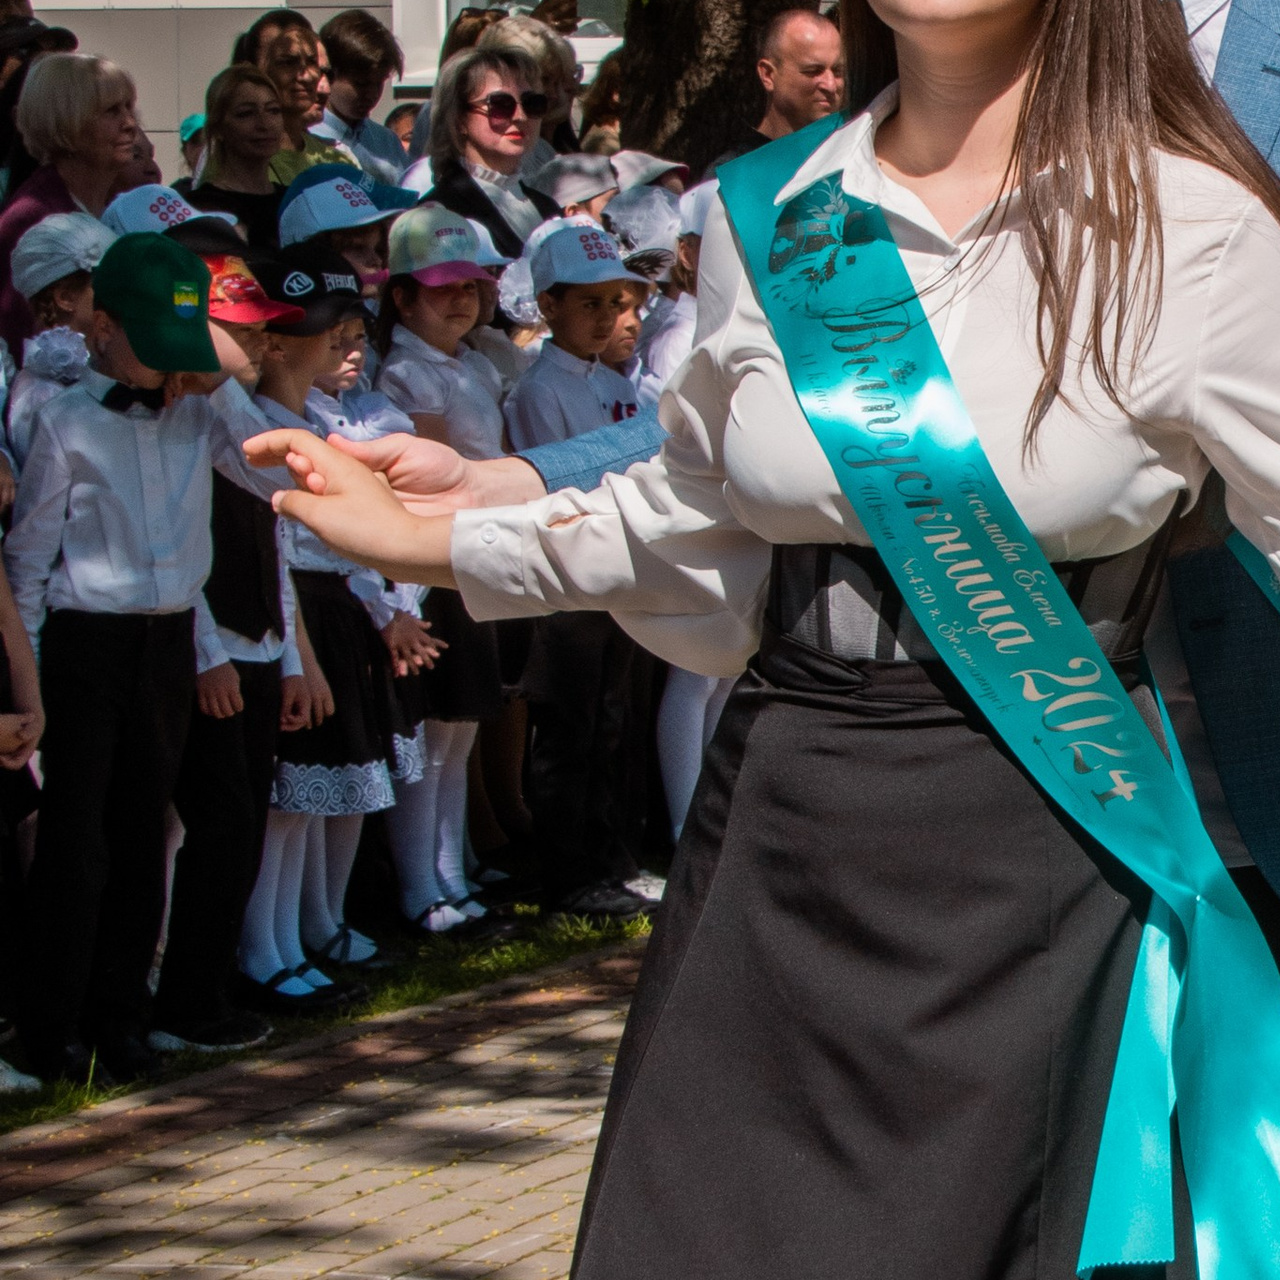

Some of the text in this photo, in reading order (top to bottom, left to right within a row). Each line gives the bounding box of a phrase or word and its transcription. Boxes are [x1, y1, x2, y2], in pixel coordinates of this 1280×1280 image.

[822, 297, 1150, 812] Выпускница 2024
[1012, 569, 1063, 627] Елена
